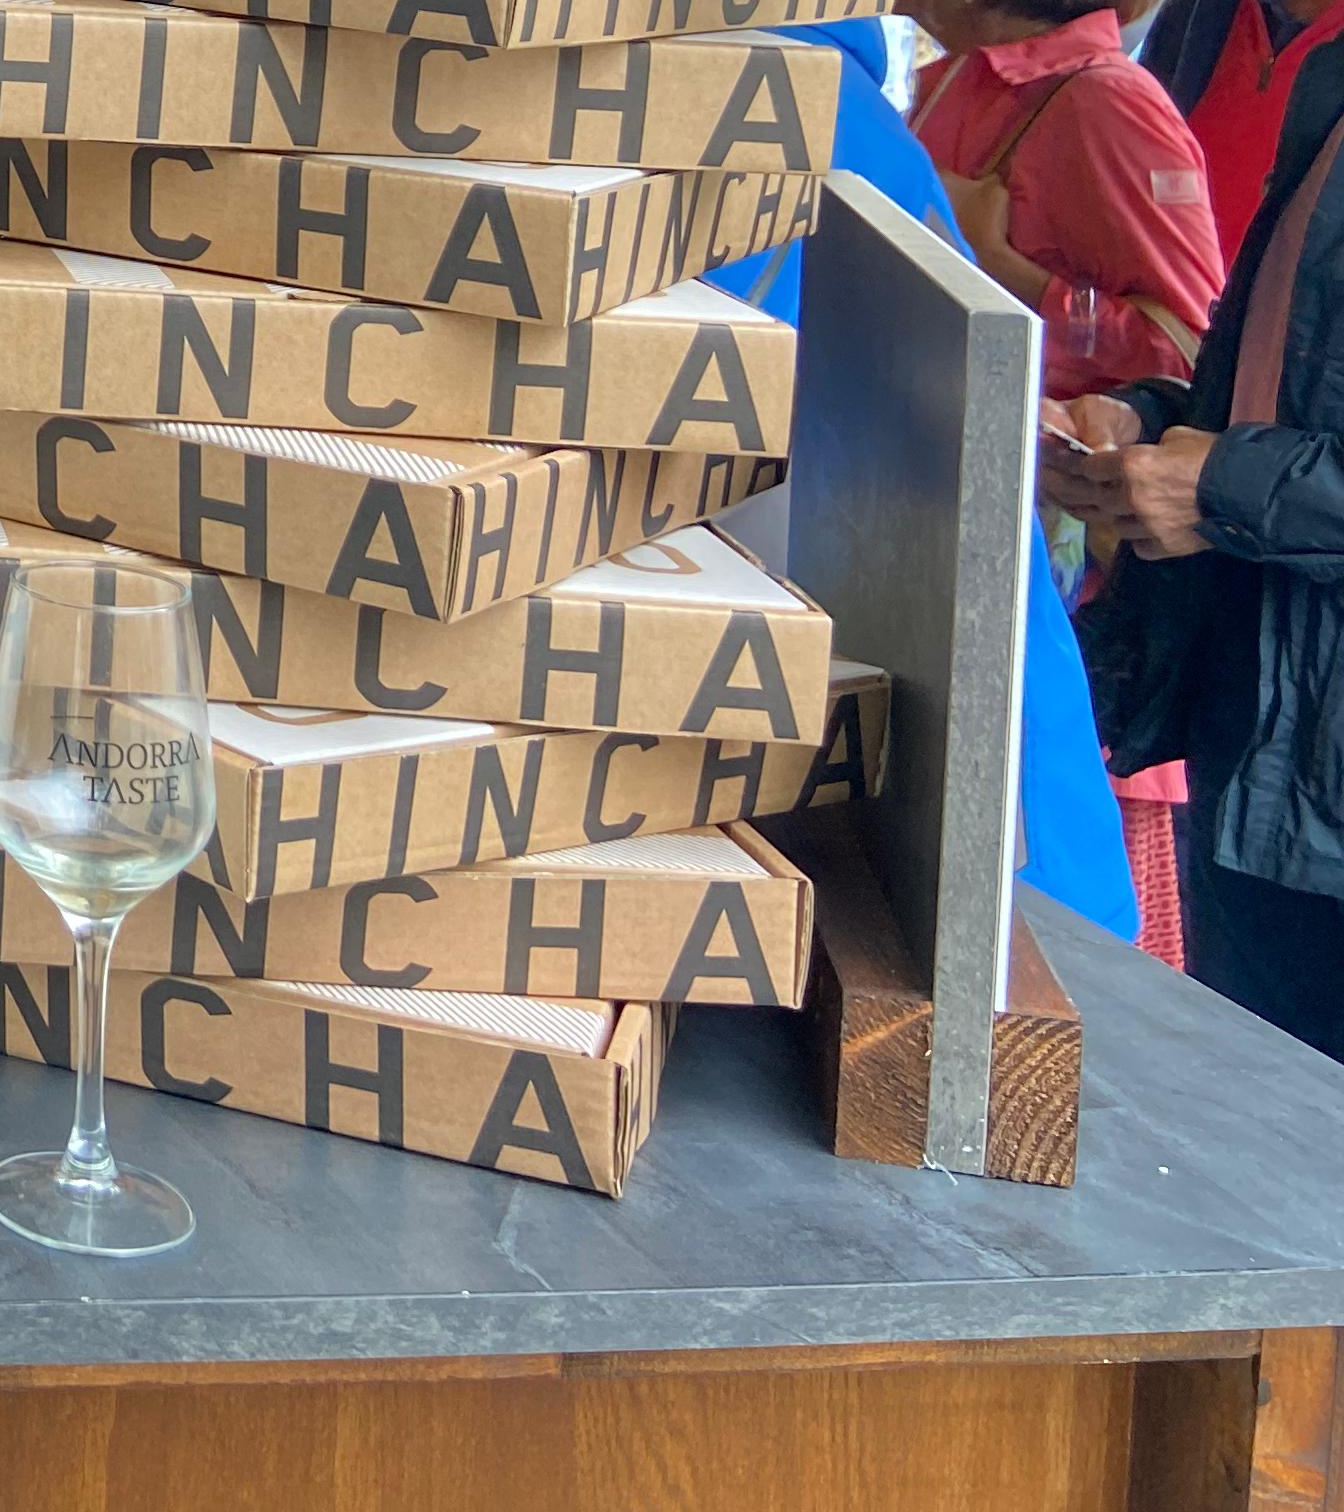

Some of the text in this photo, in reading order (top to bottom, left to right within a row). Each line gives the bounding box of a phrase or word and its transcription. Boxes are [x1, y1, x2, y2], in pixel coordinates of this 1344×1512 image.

[571, 172, 814, 323] HINCHA
[47, 731, 203, 772] ANDORRA
[82, 774, 181, 806] TASTE
[253, 692, 868, 896] HINCHA
